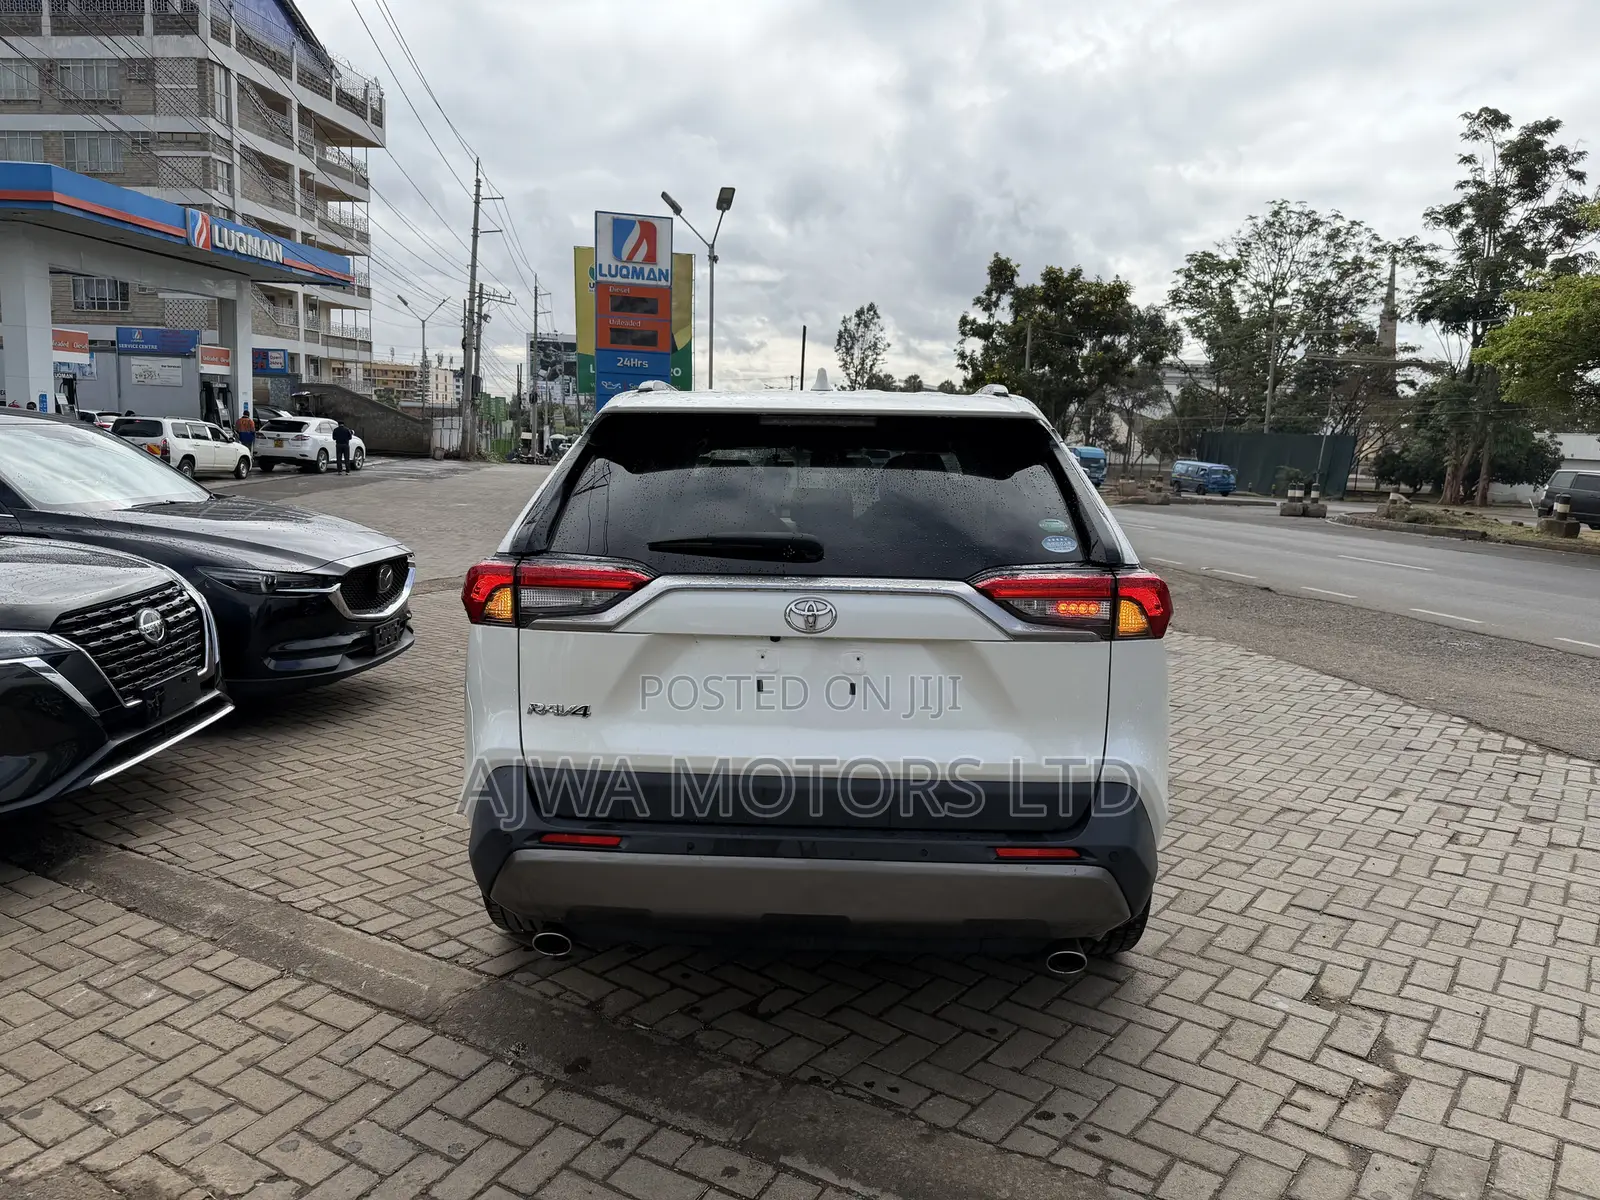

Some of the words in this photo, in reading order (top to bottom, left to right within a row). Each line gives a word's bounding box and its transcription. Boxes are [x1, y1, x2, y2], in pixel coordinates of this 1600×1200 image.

[211, 224, 283, 263] LUQMAN
[598, 263, 669, 282] LUQMAN
[609, 285, 630, 294] Diesel
[609, 318, 641, 327] Unleaded
[616, 356, 648, 368] 24Hrs
[526, 702, 592, 718] RAV4
